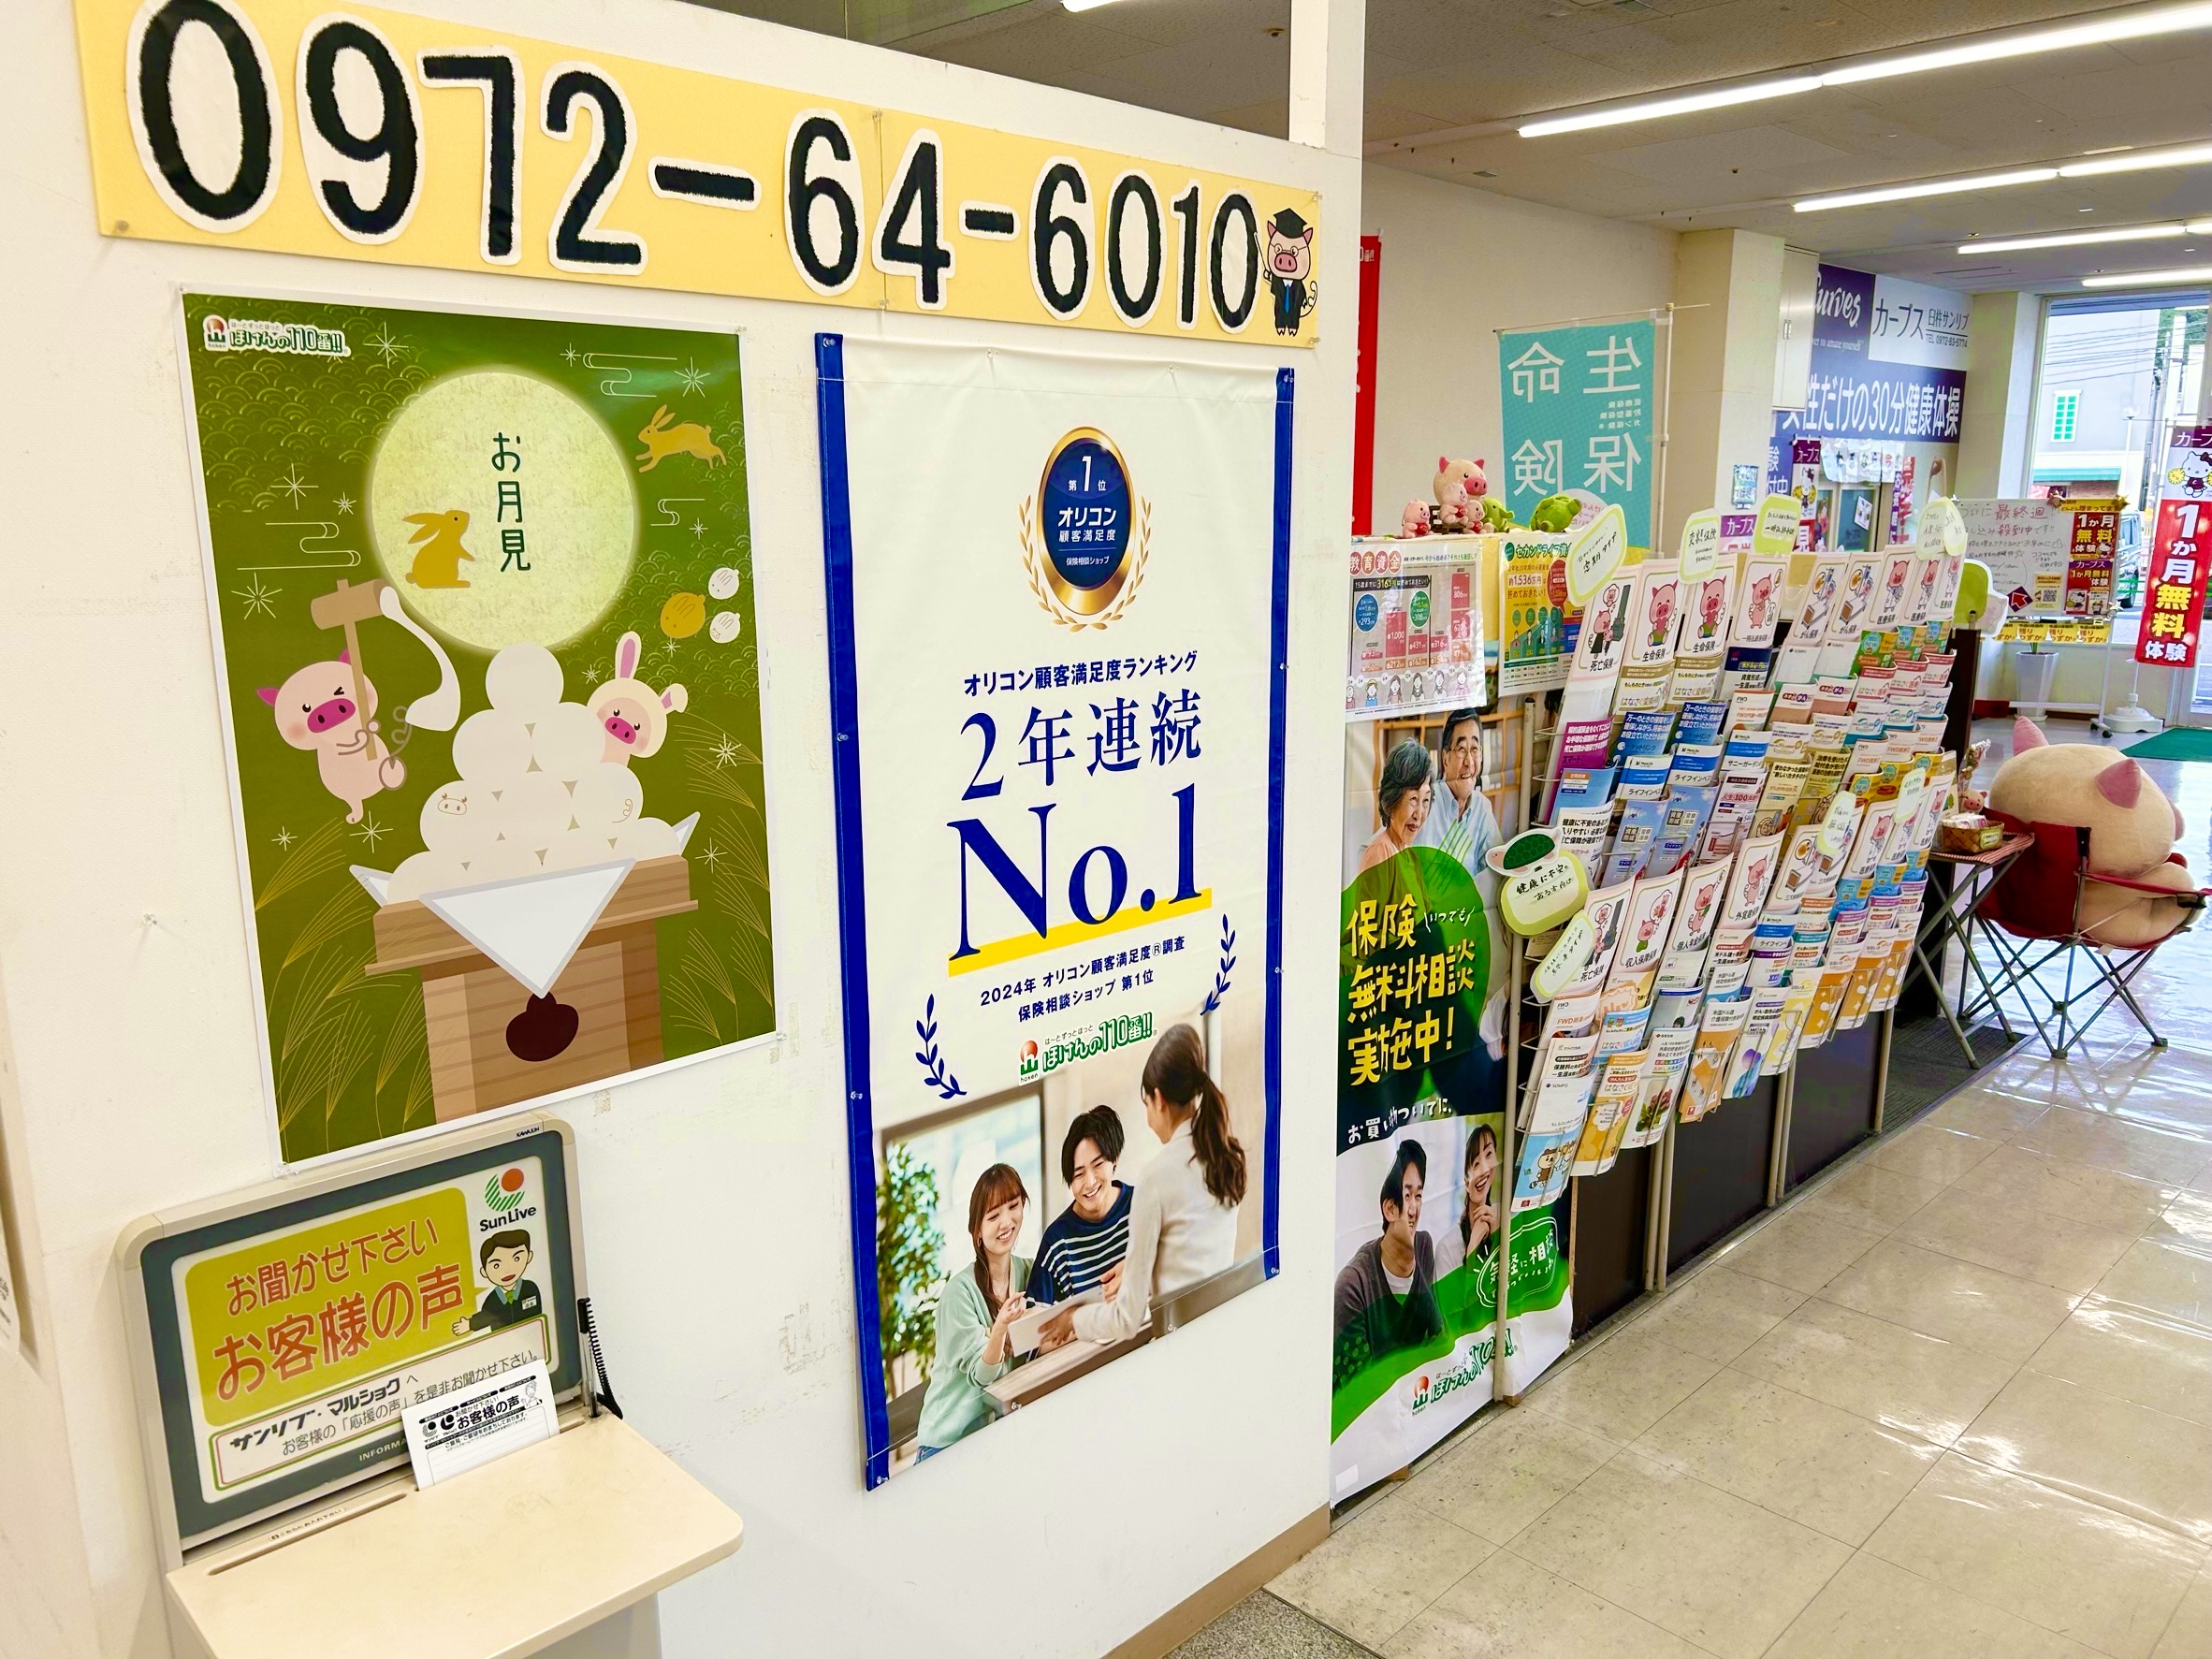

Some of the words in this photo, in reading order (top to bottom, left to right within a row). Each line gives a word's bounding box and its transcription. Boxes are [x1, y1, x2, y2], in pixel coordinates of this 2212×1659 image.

[139, 0, 1257, 327] 0972-64-6010
[1872, 298, 1924, 341] カーブス
[491, 431, 531, 574] お月見
[1057, 506, 1117, 527] オリコン
[1058, 530, 1116, 543] 顧客満足度
[964, 649, 1198, 697] オリコン顧客満足度ランキング
[960, 688, 1201, 801] 2年連続
[946, 782, 1202, 961] No.1
[1346, 892, 1418, 959] 保険
[1429, 907, 1467, 926] いつでも
[981, 979, 1037, 1008] 2024年
[1018, 982, 1116, 1023] 保険相談ショップ
[1121, 969, 1154, 992] 第1位
[1348, 938, 1476, 1024] 無料相談
[1041, 1011, 1153, 1071] ほけんの110番!!
[1347, 1006, 1455, 1087] 実施中!
[226, 1217, 440, 1317] お聞かせ下さい
[213, 1262, 464, 1402] お客様の声
[229, 1377, 400, 1451] サンリブ・マルショク
[458, 1395, 520, 1430] お客様の声
[359, 1440, 410, 1462] INFORMA
